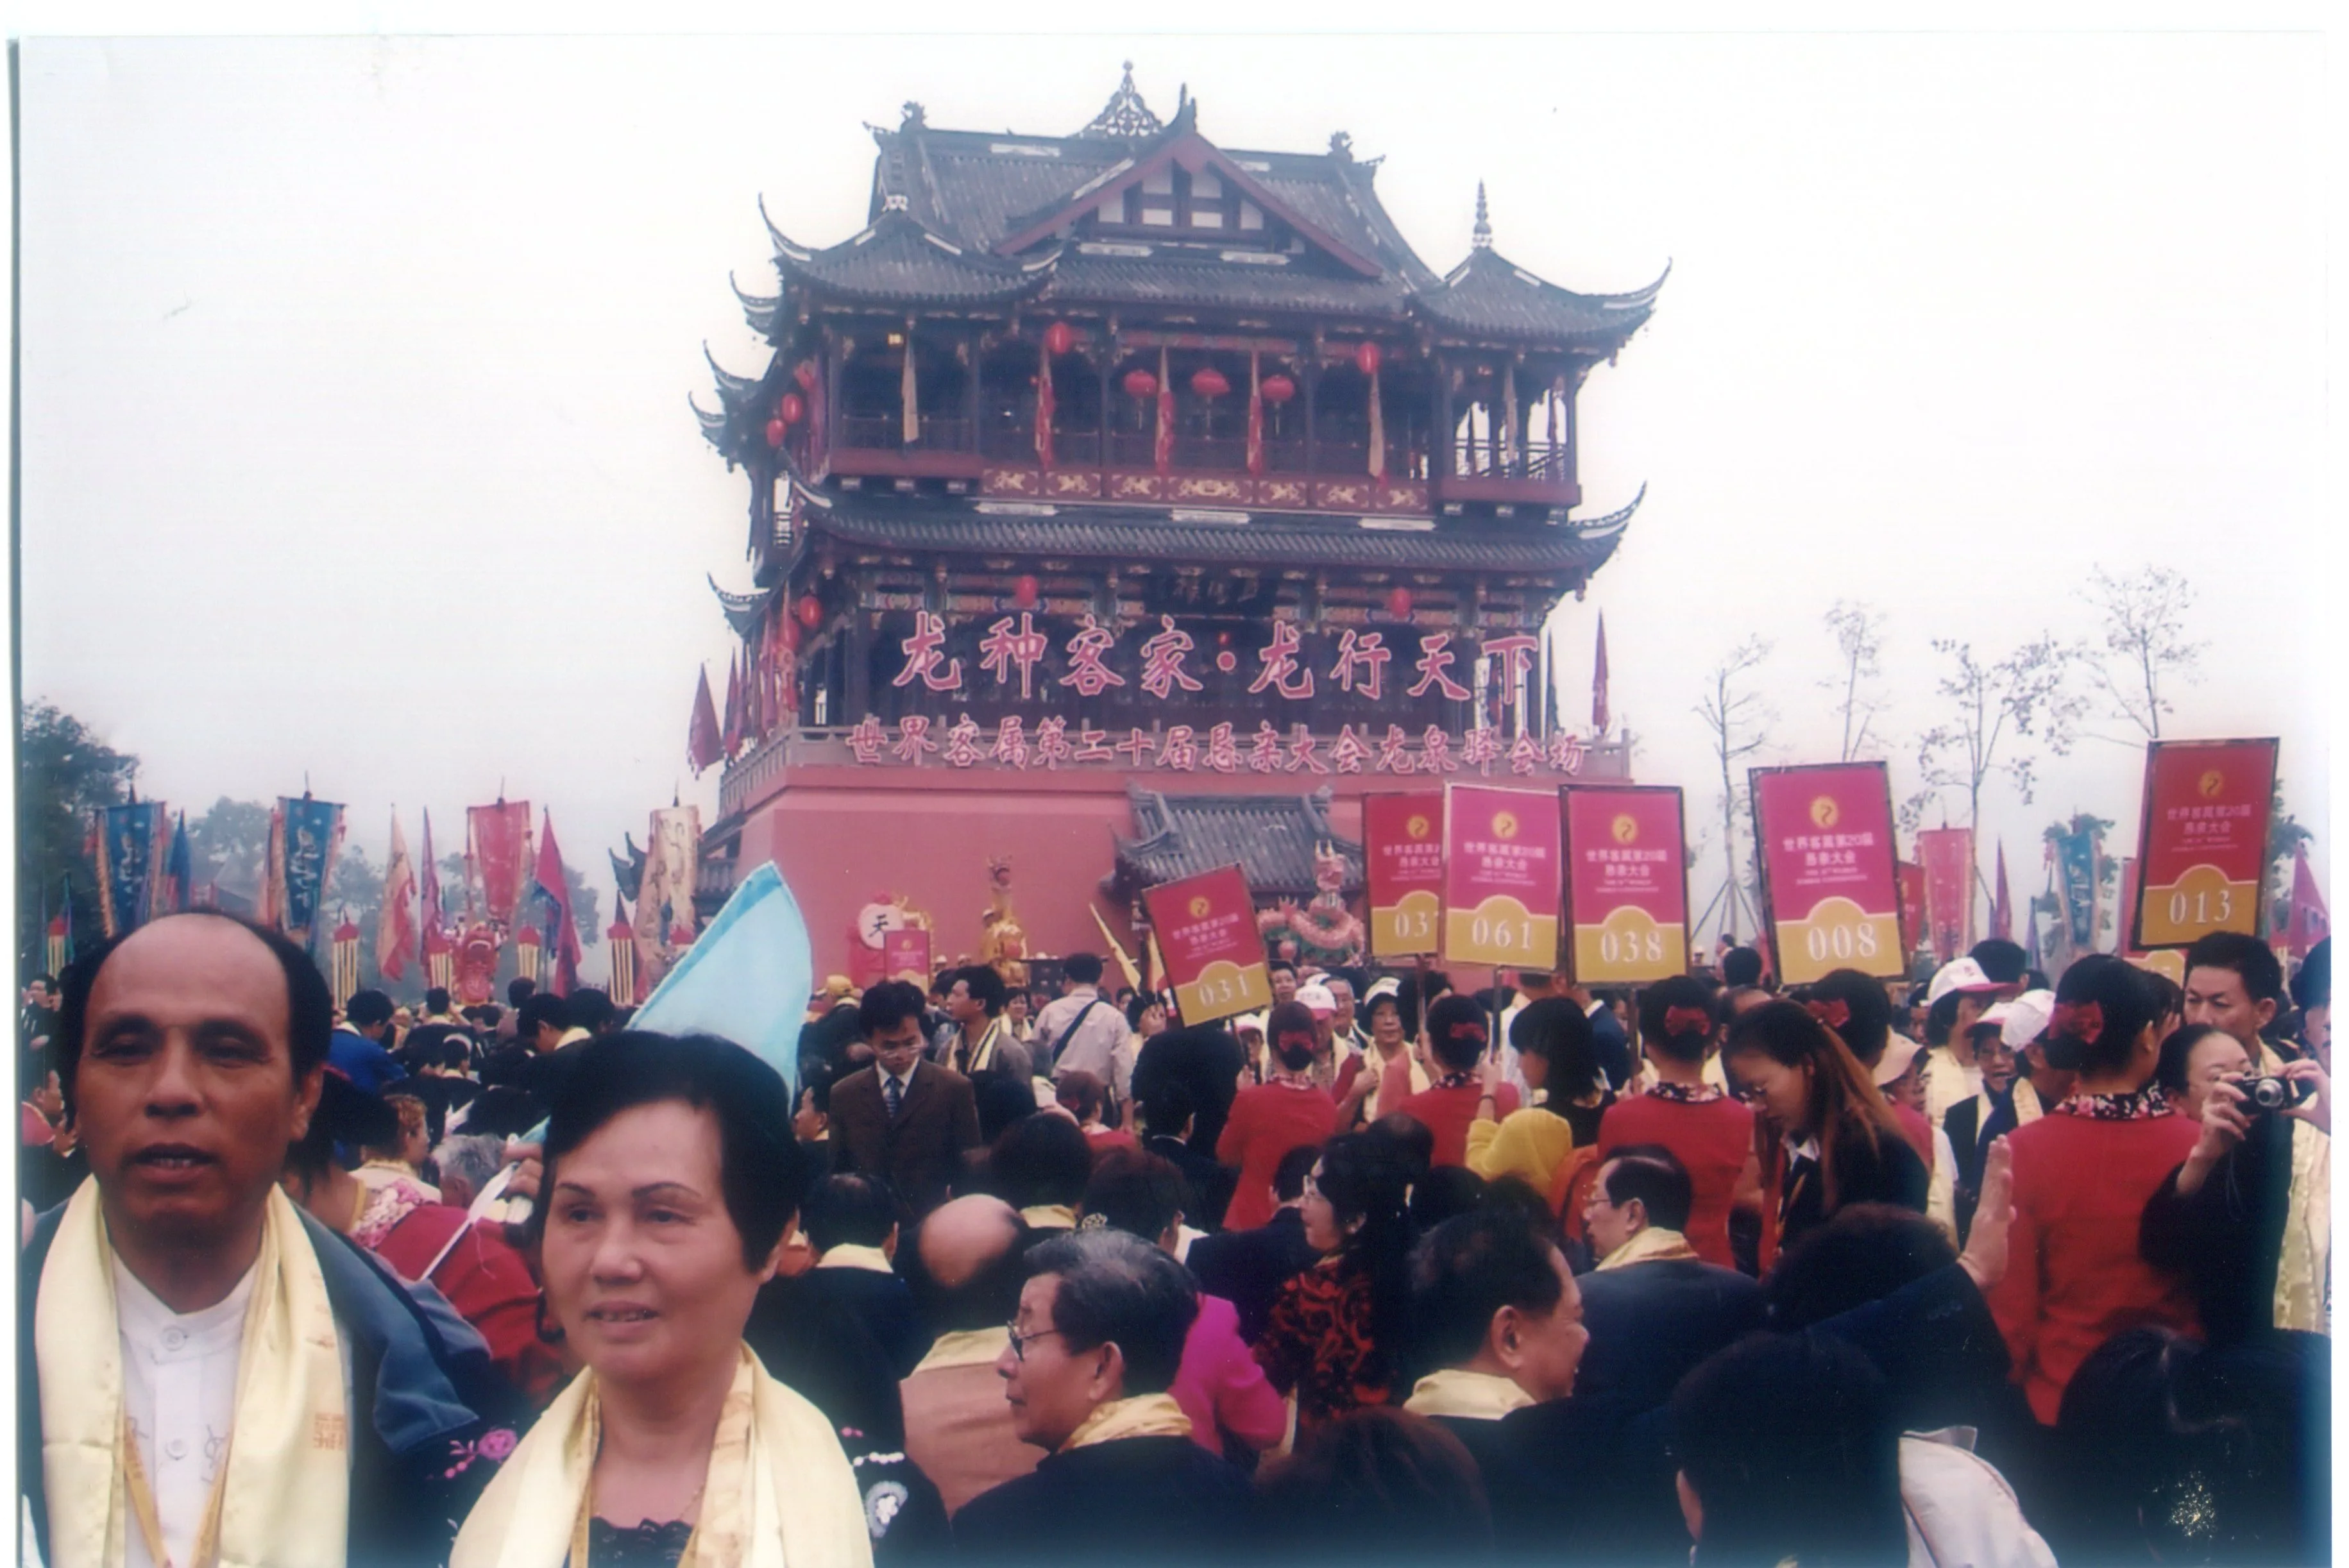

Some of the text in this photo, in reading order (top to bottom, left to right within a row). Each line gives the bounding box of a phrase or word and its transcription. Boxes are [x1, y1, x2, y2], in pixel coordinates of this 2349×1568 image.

[892, 610, 1539, 705] 龙种客家·龙行天下
[1395, 911, 1439, 938] 03
[2169, 890, 2231, 925] 013
[1471, 916, 1532, 950] 061
[1599, 930, 1663, 963] 038
[1807, 923, 1877, 961] 008
[1199, 972, 1250, 1007] 031
